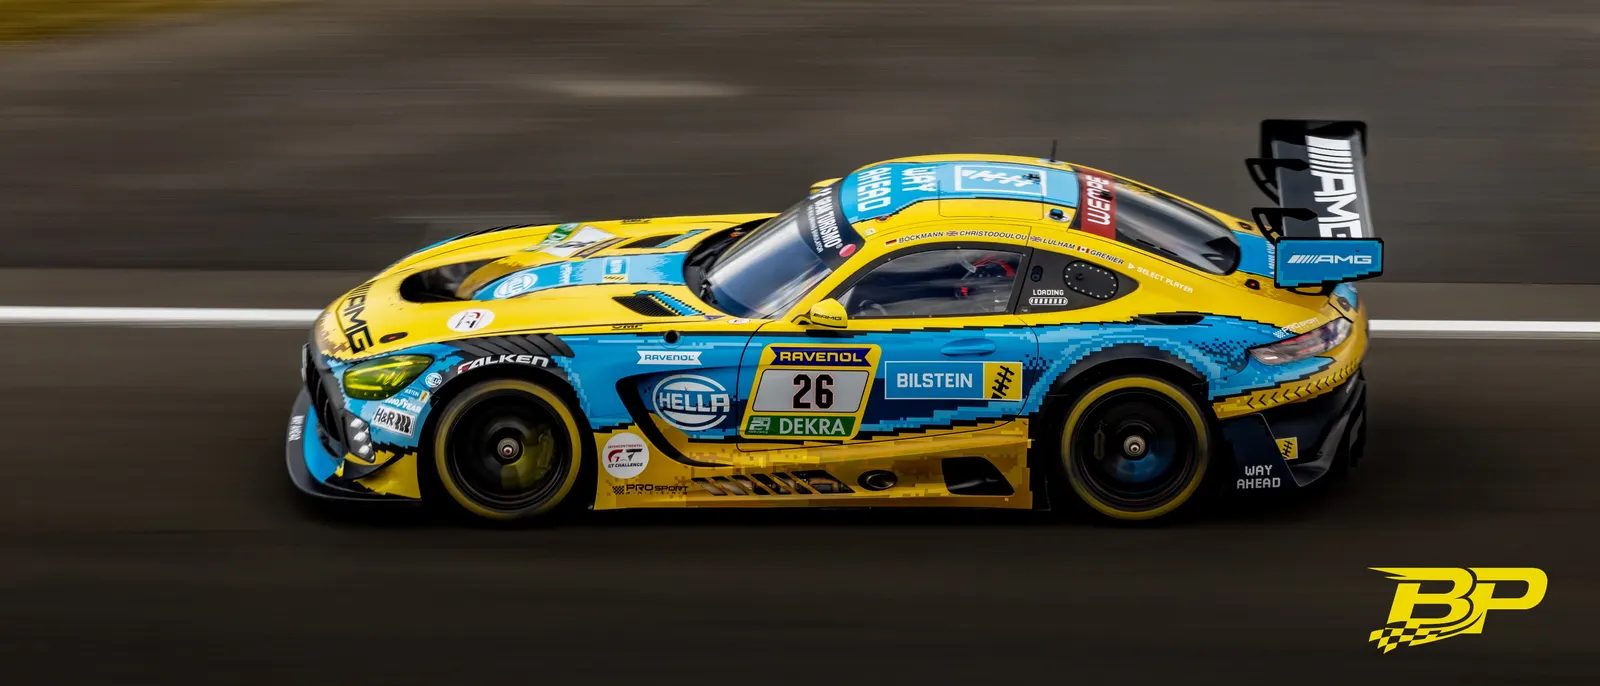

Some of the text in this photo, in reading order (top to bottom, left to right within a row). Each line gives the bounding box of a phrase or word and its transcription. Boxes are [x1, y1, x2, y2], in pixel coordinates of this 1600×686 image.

[901, 166, 937, 192] WAY
[857, 167, 892, 213] AHEAD
[1085, 175, 1111, 226] WEMPE
[959, 230, 1028, 240] CHRISTODOULOU
[1042, 238, 1076, 250] LULHAM
[1089, 249, 1125, 265] GRENIER
[1314, 254, 1373, 265] AMG
[1136, 266, 1194, 294] SELECT PLAYER
[457, 353, 550, 375] FALKEN
[779, 351, 863, 363] RAVENOL
[896, 373, 973, 388] BILSTEIN
[792, 373, 835, 409] 26
[658, 391, 731, 413] HELLA
[373, 407, 396, 426] H&R
[779, 417, 846, 435] DEKRA
[1244, 464, 1273, 476] WAY
[626, 484, 654, 492] PRO
[1236, 477, 1281, 489] AHEAD
